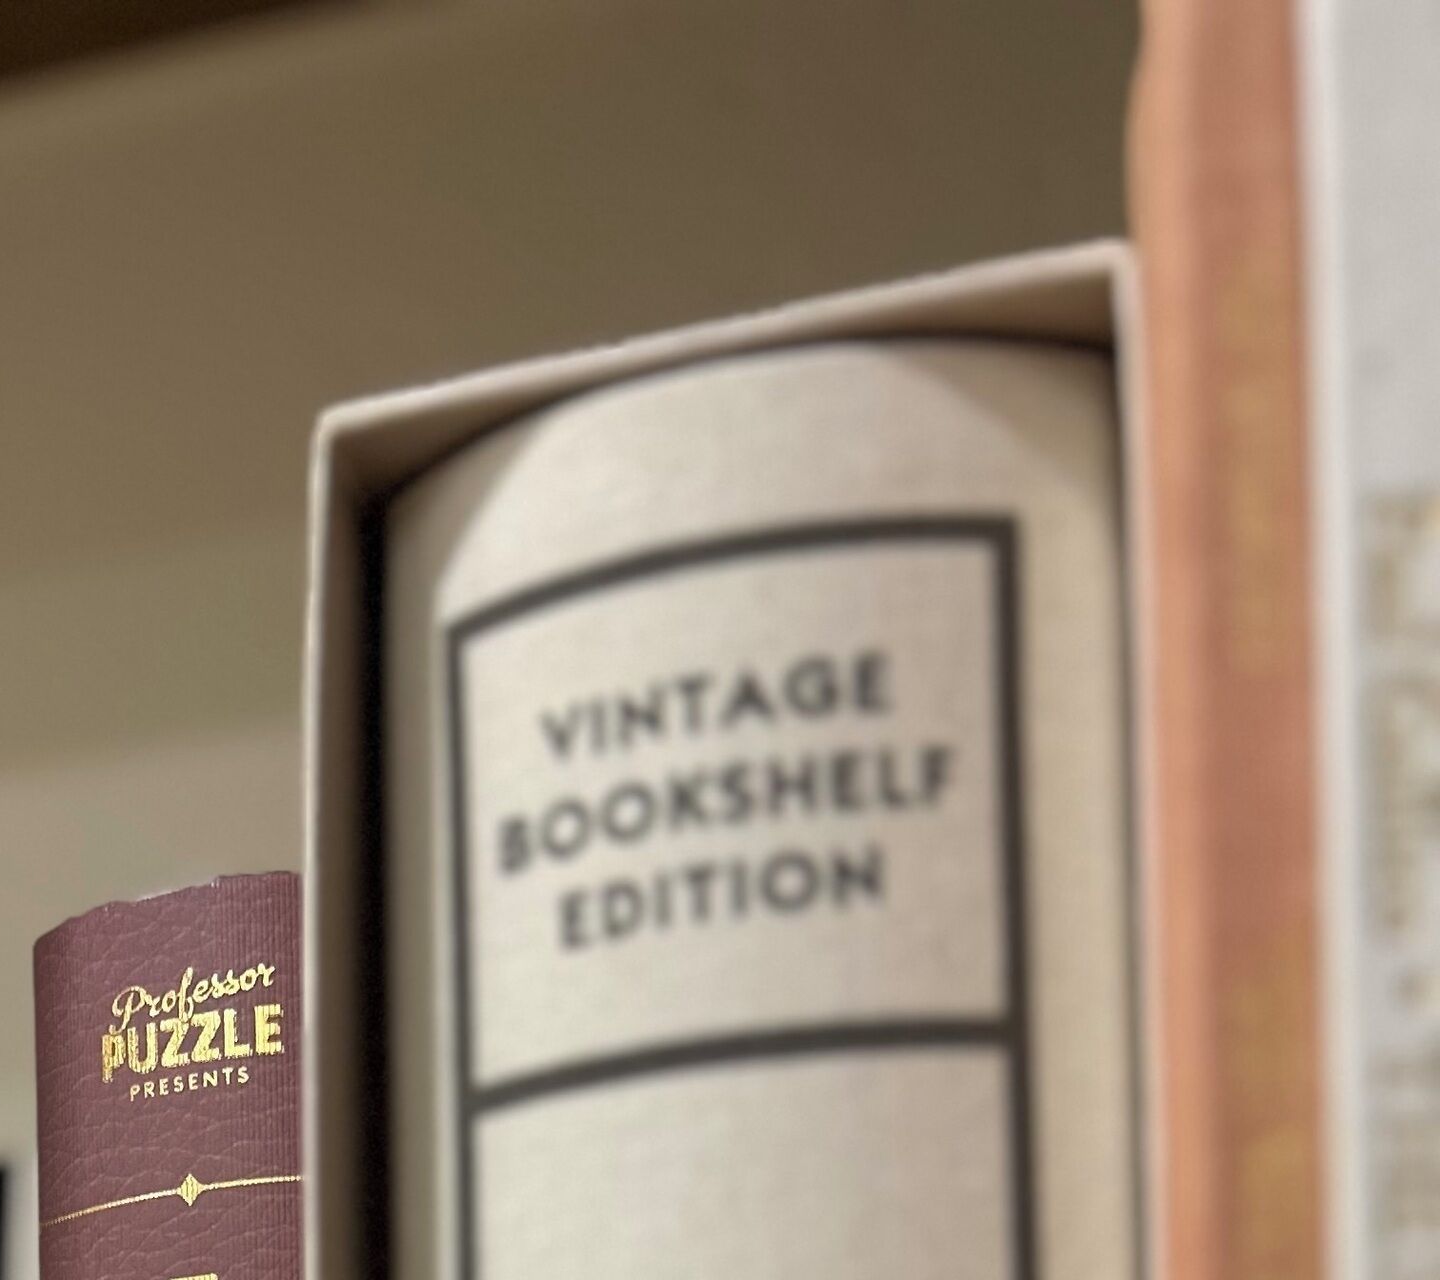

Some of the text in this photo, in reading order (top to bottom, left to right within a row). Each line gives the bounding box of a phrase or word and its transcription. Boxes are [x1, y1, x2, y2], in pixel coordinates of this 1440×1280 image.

[538, 646, 893, 764] VINTAGE
[495, 742, 955, 878] BOOKSHELF
[557, 846, 886, 954] EDITION
[101, 1003, 285, 1083] PUZZLE
[110, 963, 276, 1033] Professor
[129, 1066, 250, 1101] PRESENTS
